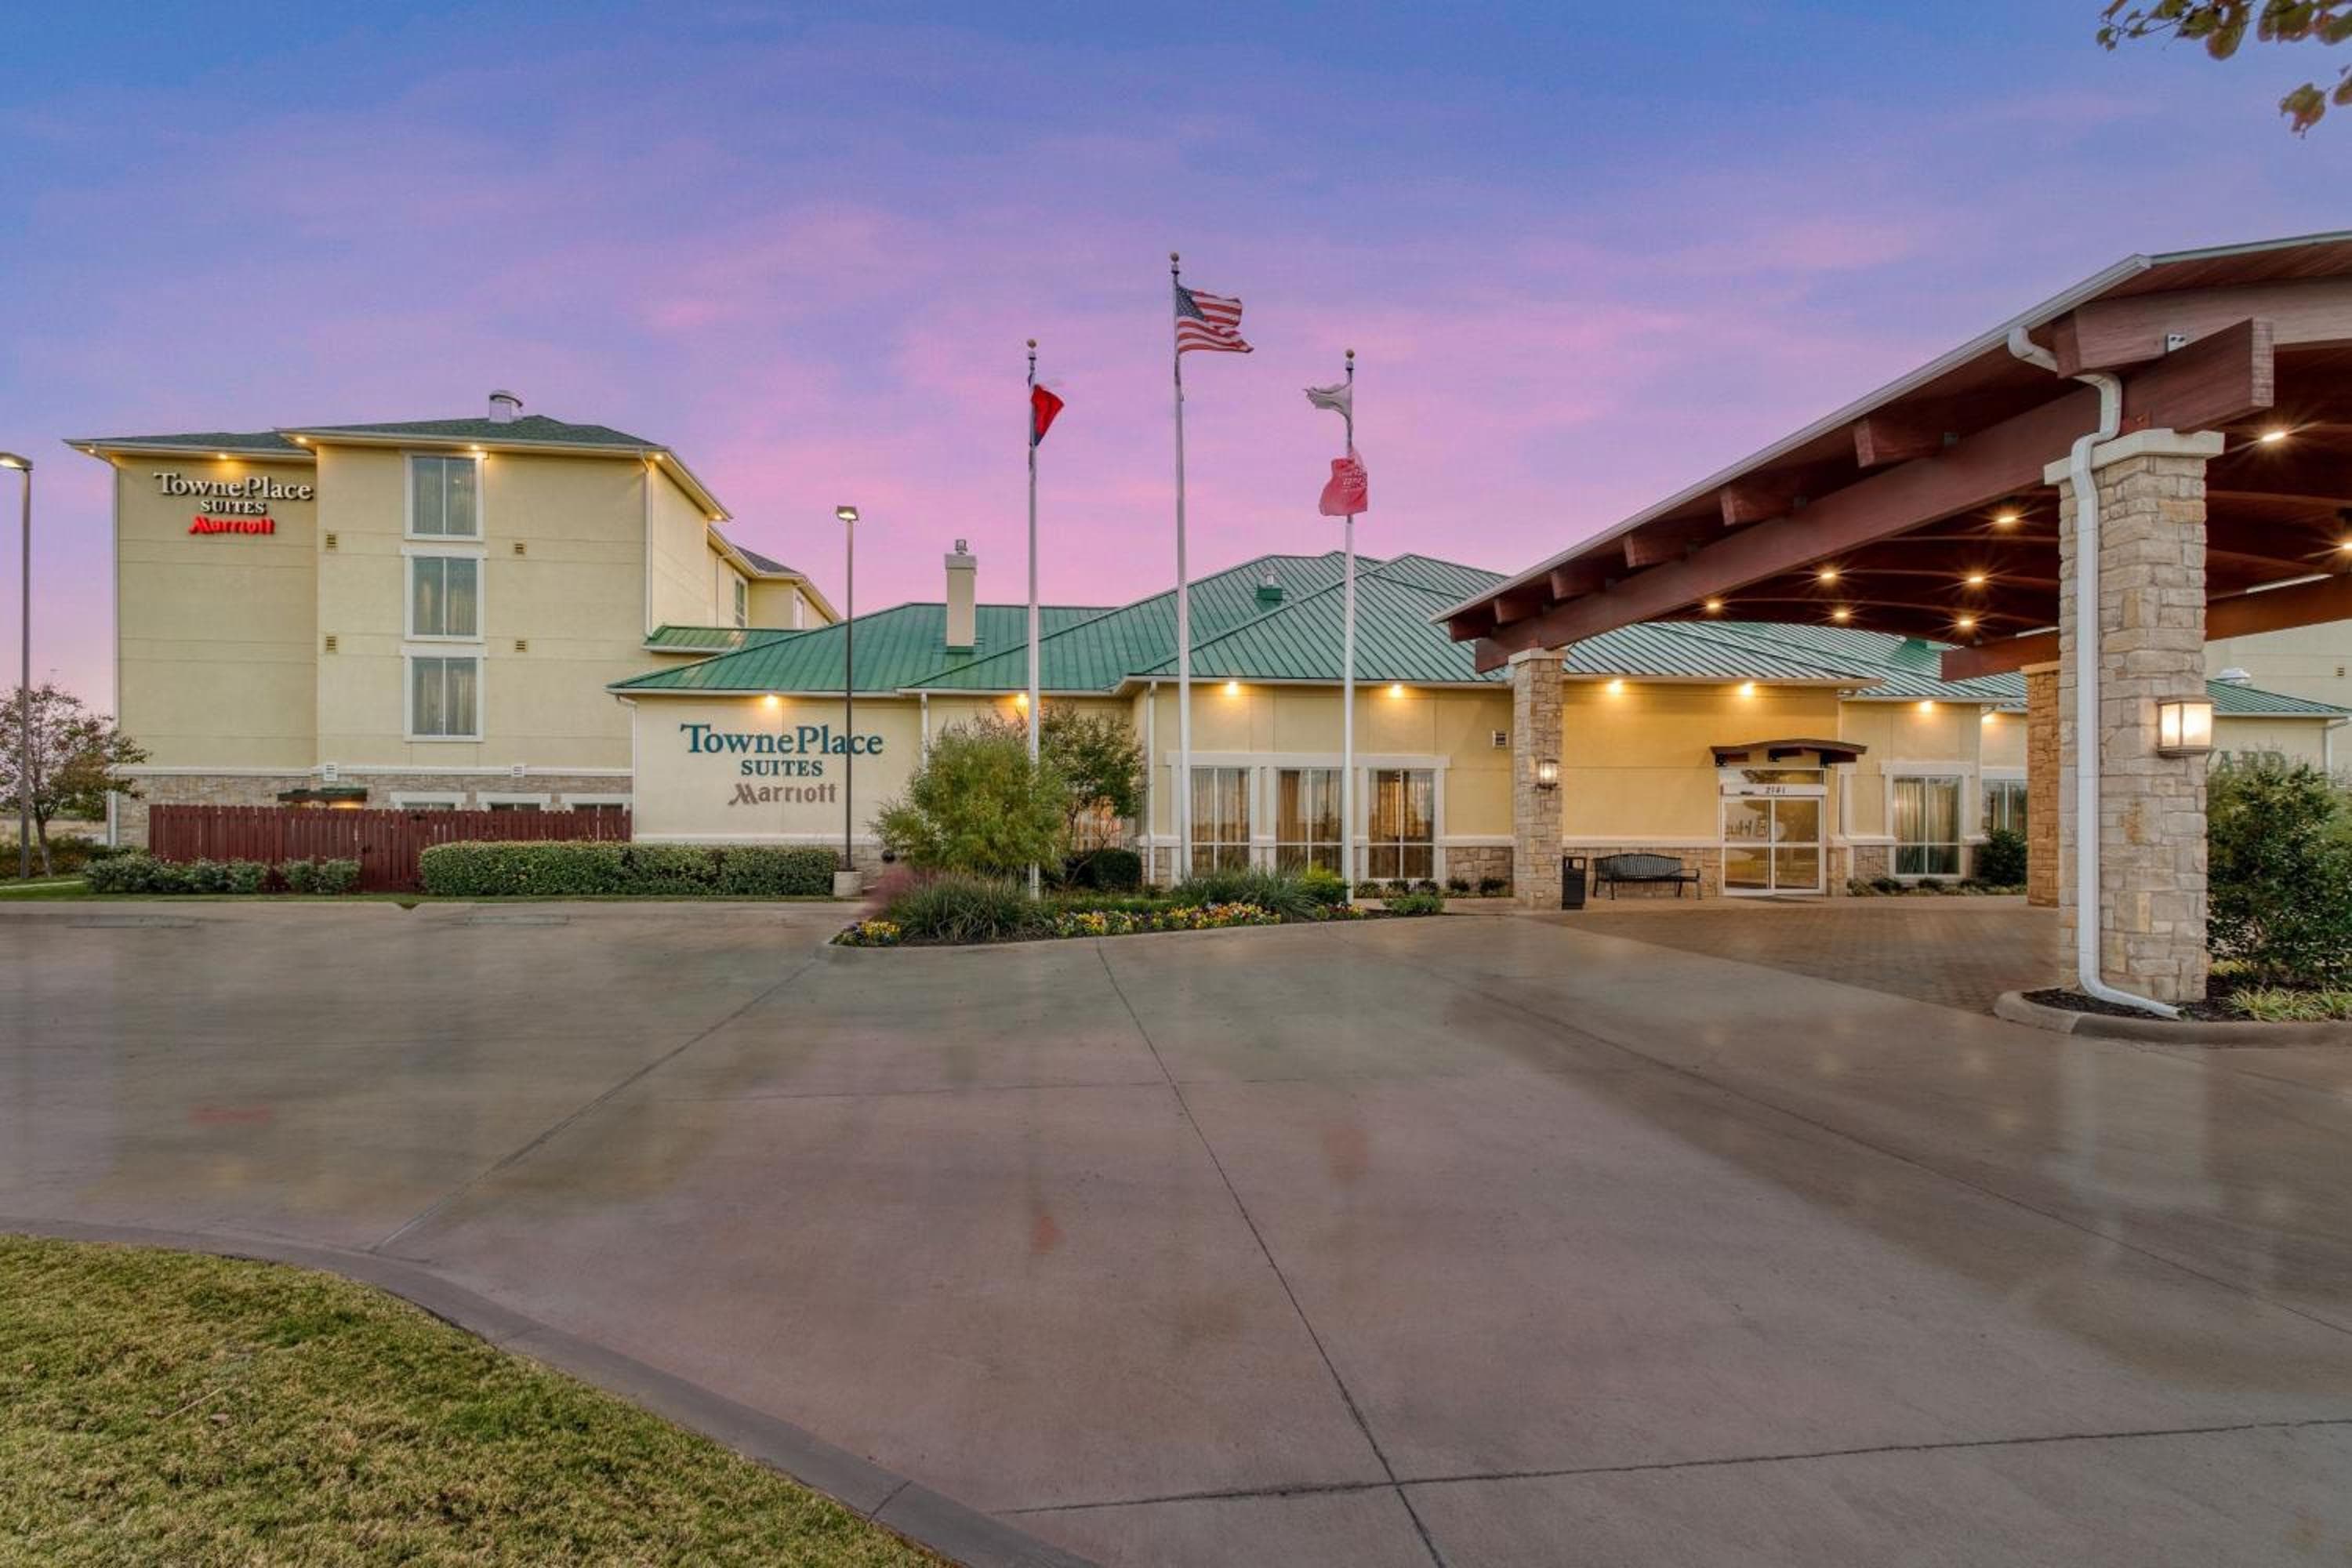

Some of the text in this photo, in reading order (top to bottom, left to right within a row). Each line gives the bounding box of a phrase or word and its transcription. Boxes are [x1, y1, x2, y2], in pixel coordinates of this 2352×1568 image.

[153, 472, 314, 500] TownePlace
[200, 499, 266, 514] SUITES
[680, 724, 884, 755] TownePlace
[741, 760, 823, 776] SUITES
[728, 782, 837, 806] Marriott
